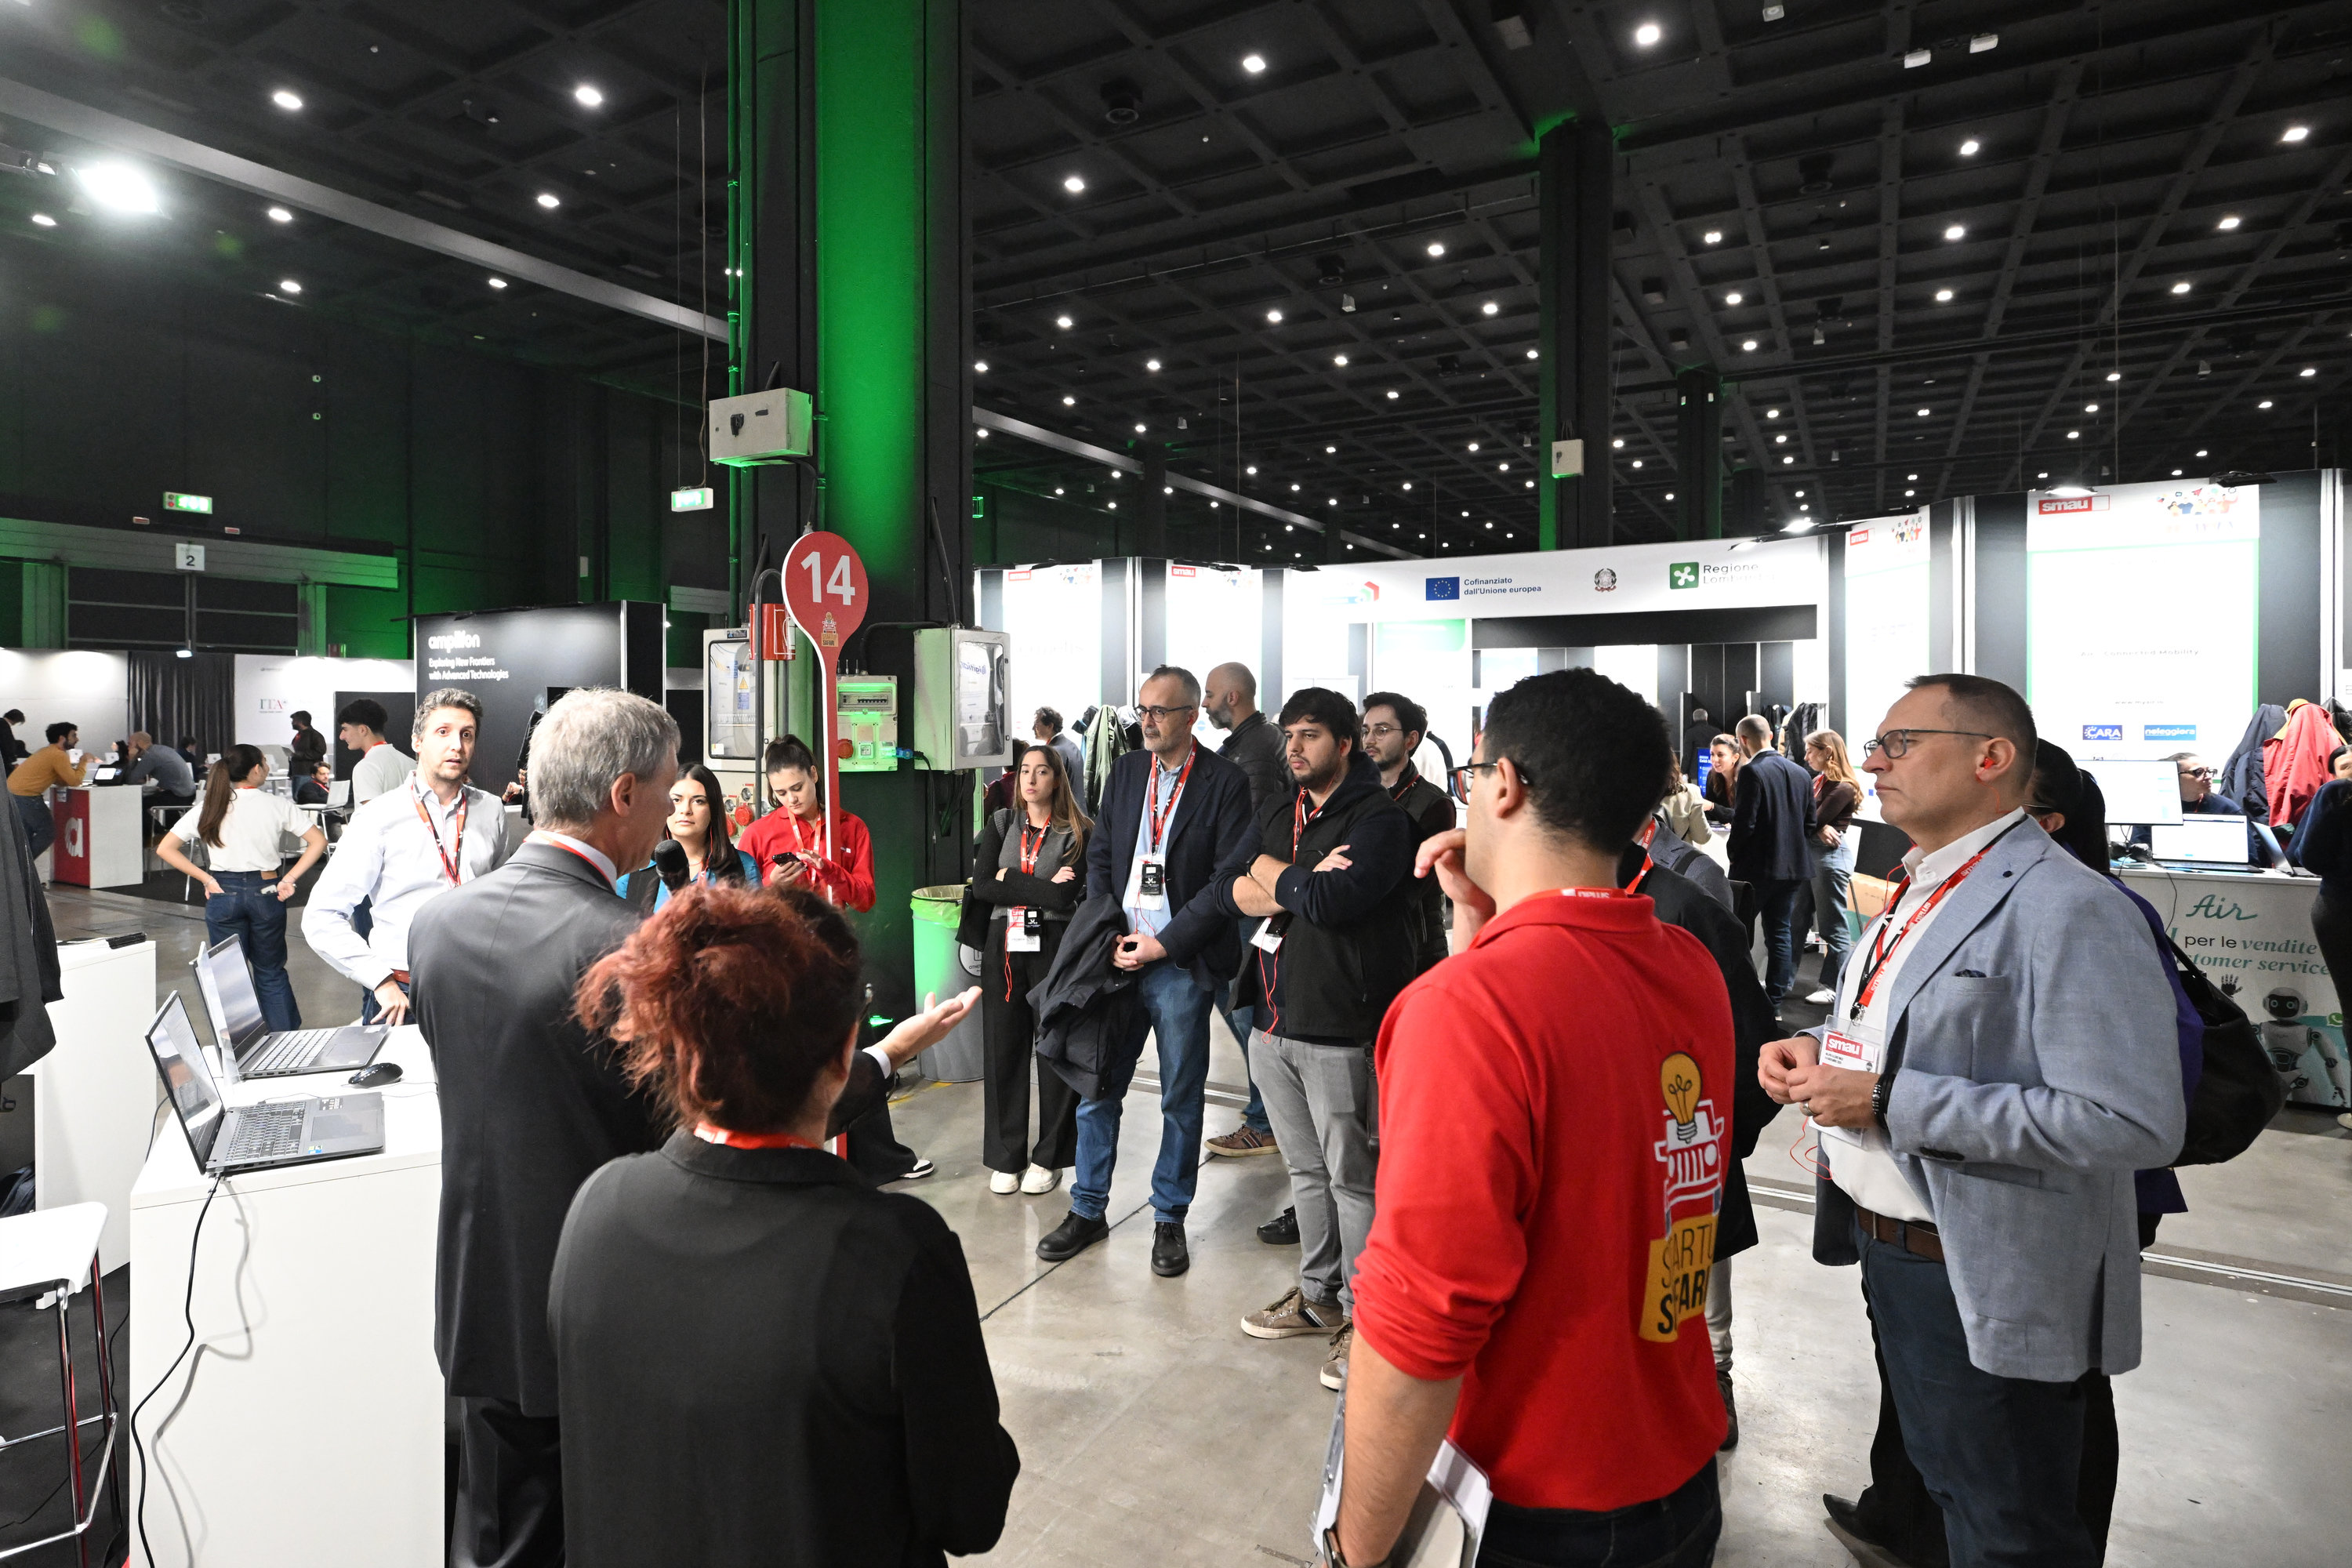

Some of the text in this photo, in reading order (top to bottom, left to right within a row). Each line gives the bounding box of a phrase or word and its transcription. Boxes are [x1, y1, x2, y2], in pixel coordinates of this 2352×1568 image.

[2042, 499, 2089, 512] smau
[186, 555, 194, 566] 2
[1703, 563, 1759, 575] Regione
[800, 551, 855, 605] 14
[1464, 576, 1513, 586] Cofinanziato
[1464, 586, 1542, 596] dall'Unione europea
[428, 655, 495, 670] Exploring New Frontiers
[428, 668, 510, 681] with Advanced Technologies
[2086, 728, 2122, 738] CARA
[2185, 894, 2258, 921] Air
[2184, 935, 2318, 955] per le vendite
[2257, 958, 2332, 976] service
[1827, 1037, 1861, 1056] smau
